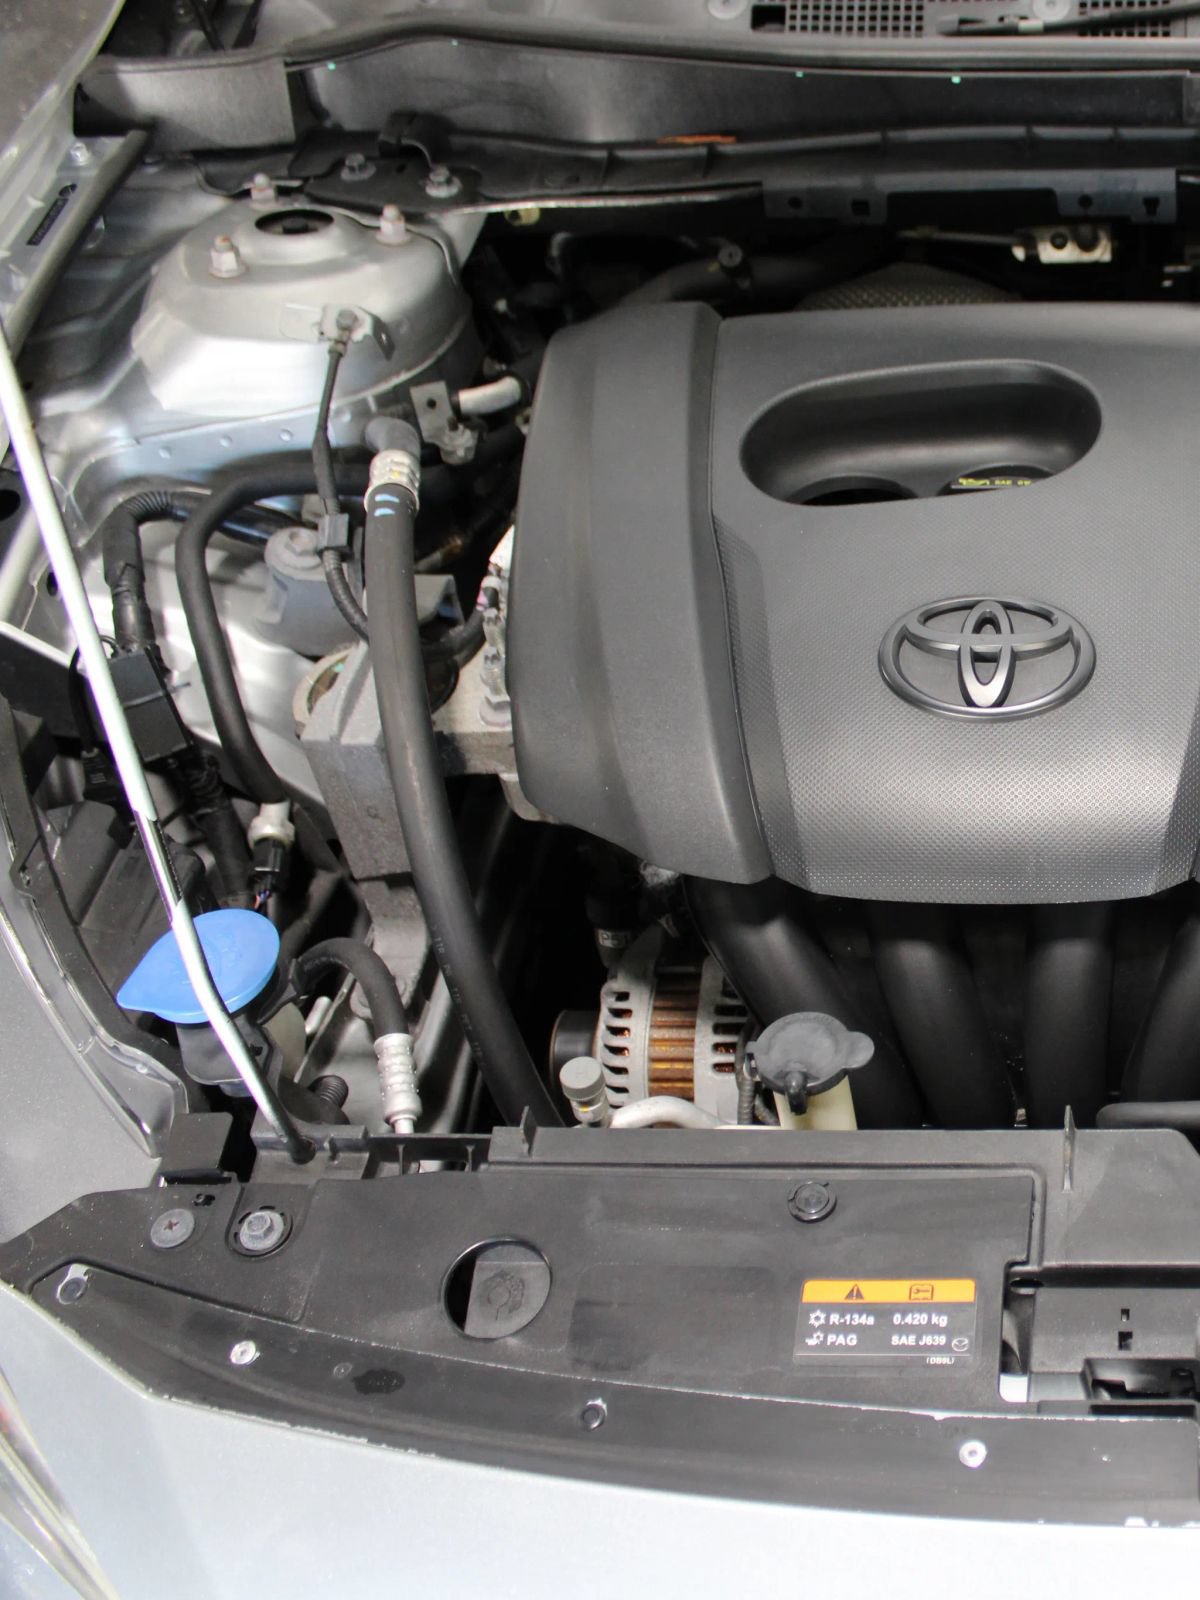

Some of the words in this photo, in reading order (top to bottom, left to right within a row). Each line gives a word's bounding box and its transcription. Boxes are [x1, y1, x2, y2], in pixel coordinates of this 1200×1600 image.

[829, 1313, 874, 1326] R-134a
[893, 1313, 928, 1325] 0.420
[931, 1313, 948, 1327] kg
[827, 1334, 857, 1346] PAG
[891, 1334, 916, 1346] SAE
[919, 1334, 946, 1346] J639
